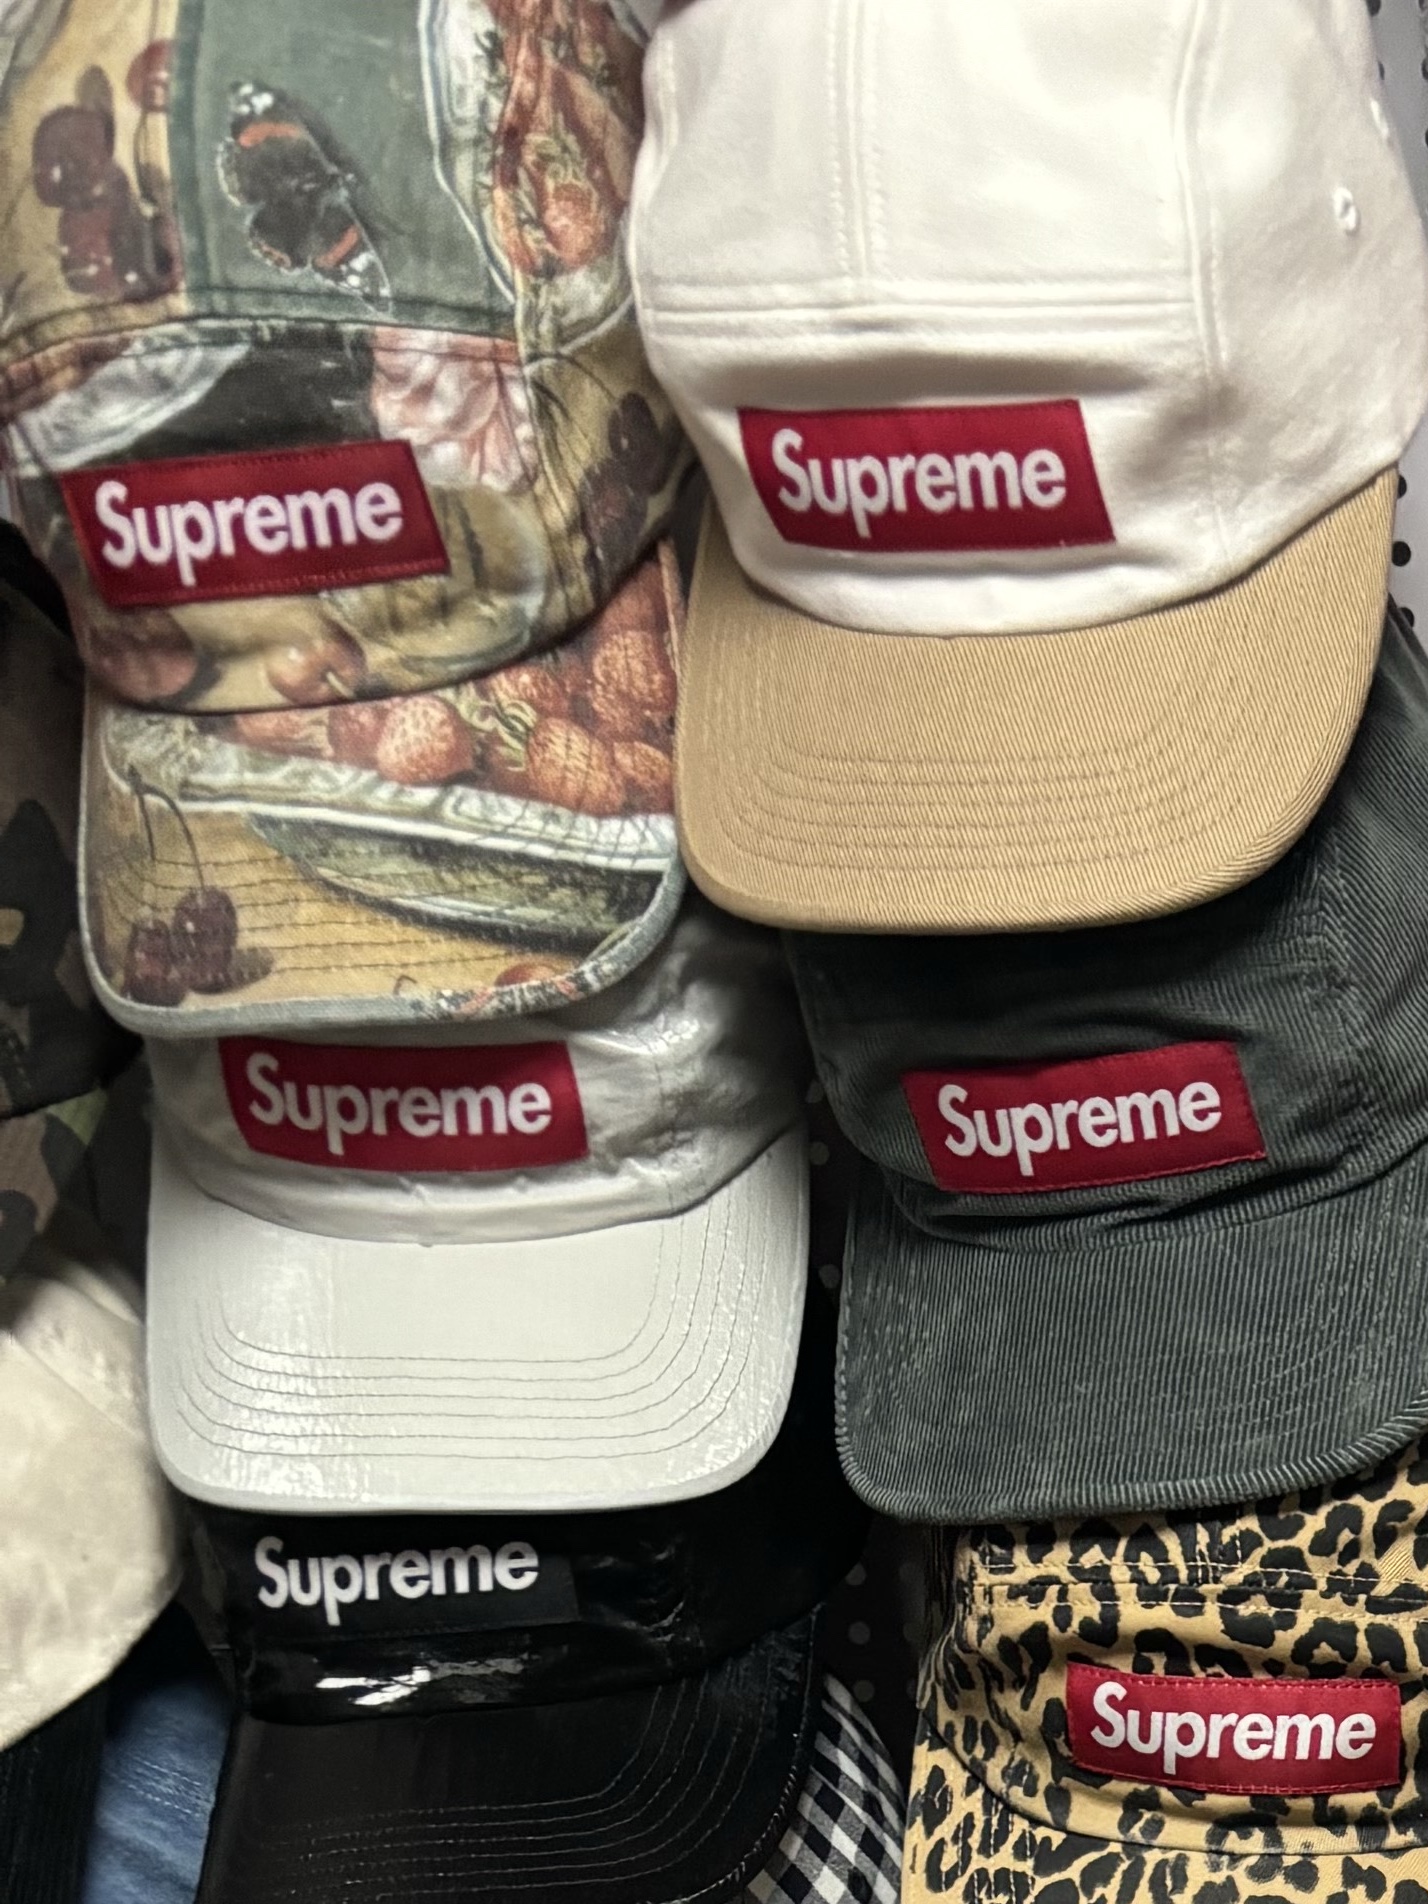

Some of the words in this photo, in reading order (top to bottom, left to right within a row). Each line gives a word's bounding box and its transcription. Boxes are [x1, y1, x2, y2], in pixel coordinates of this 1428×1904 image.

[769, 429, 1067, 536] Supreme
[96, 481, 402, 585] Supreme
[249, 1055, 552, 1155] Supreme
[939, 1082, 1221, 1175] Supreme
[256, 1548, 538, 1625] Supreme
[1092, 1681, 1376, 1773] Supreme
